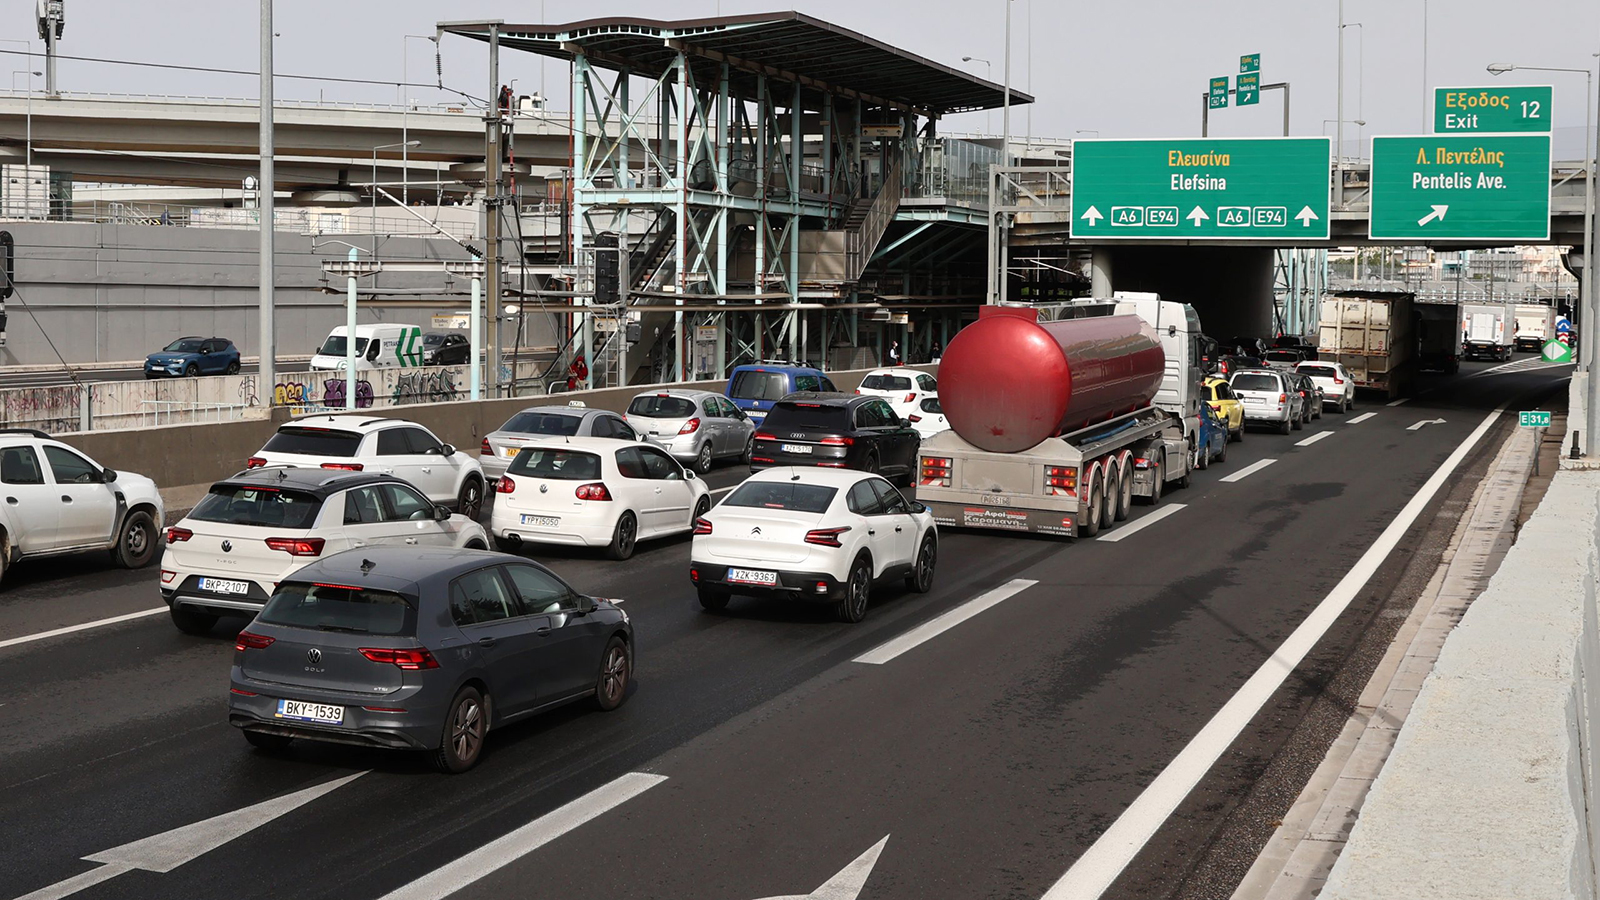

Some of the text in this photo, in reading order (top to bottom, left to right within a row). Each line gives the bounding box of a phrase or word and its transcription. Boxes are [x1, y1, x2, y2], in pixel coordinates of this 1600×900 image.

[1446, 92, 1510, 110] Εξοδος
[1520, 101, 1540, 118] 12
[1445, 114, 1478, 128] Exit
[1168, 150, 1230, 167] Ελευσίνα
[1416, 147, 1504, 168] Λ. Πεντέλης
[1170, 174, 1226, 190] Elefsina
[1412, 172, 1507, 189] Pentelis Ave.
[1118, 211, 1136, 222] A6
[1150, 211, 1174, 222] E94
[1224, 211, 1244, 222] A6
[1258, 211, 1282, 222] E94
[1522, 415, 1549, 424] E 31,8
[735, 570, 774, 582] XZK-9363
[205, 580, 247, 592] BKP-2107
[286, 702, 341, 720] BKY-1539
